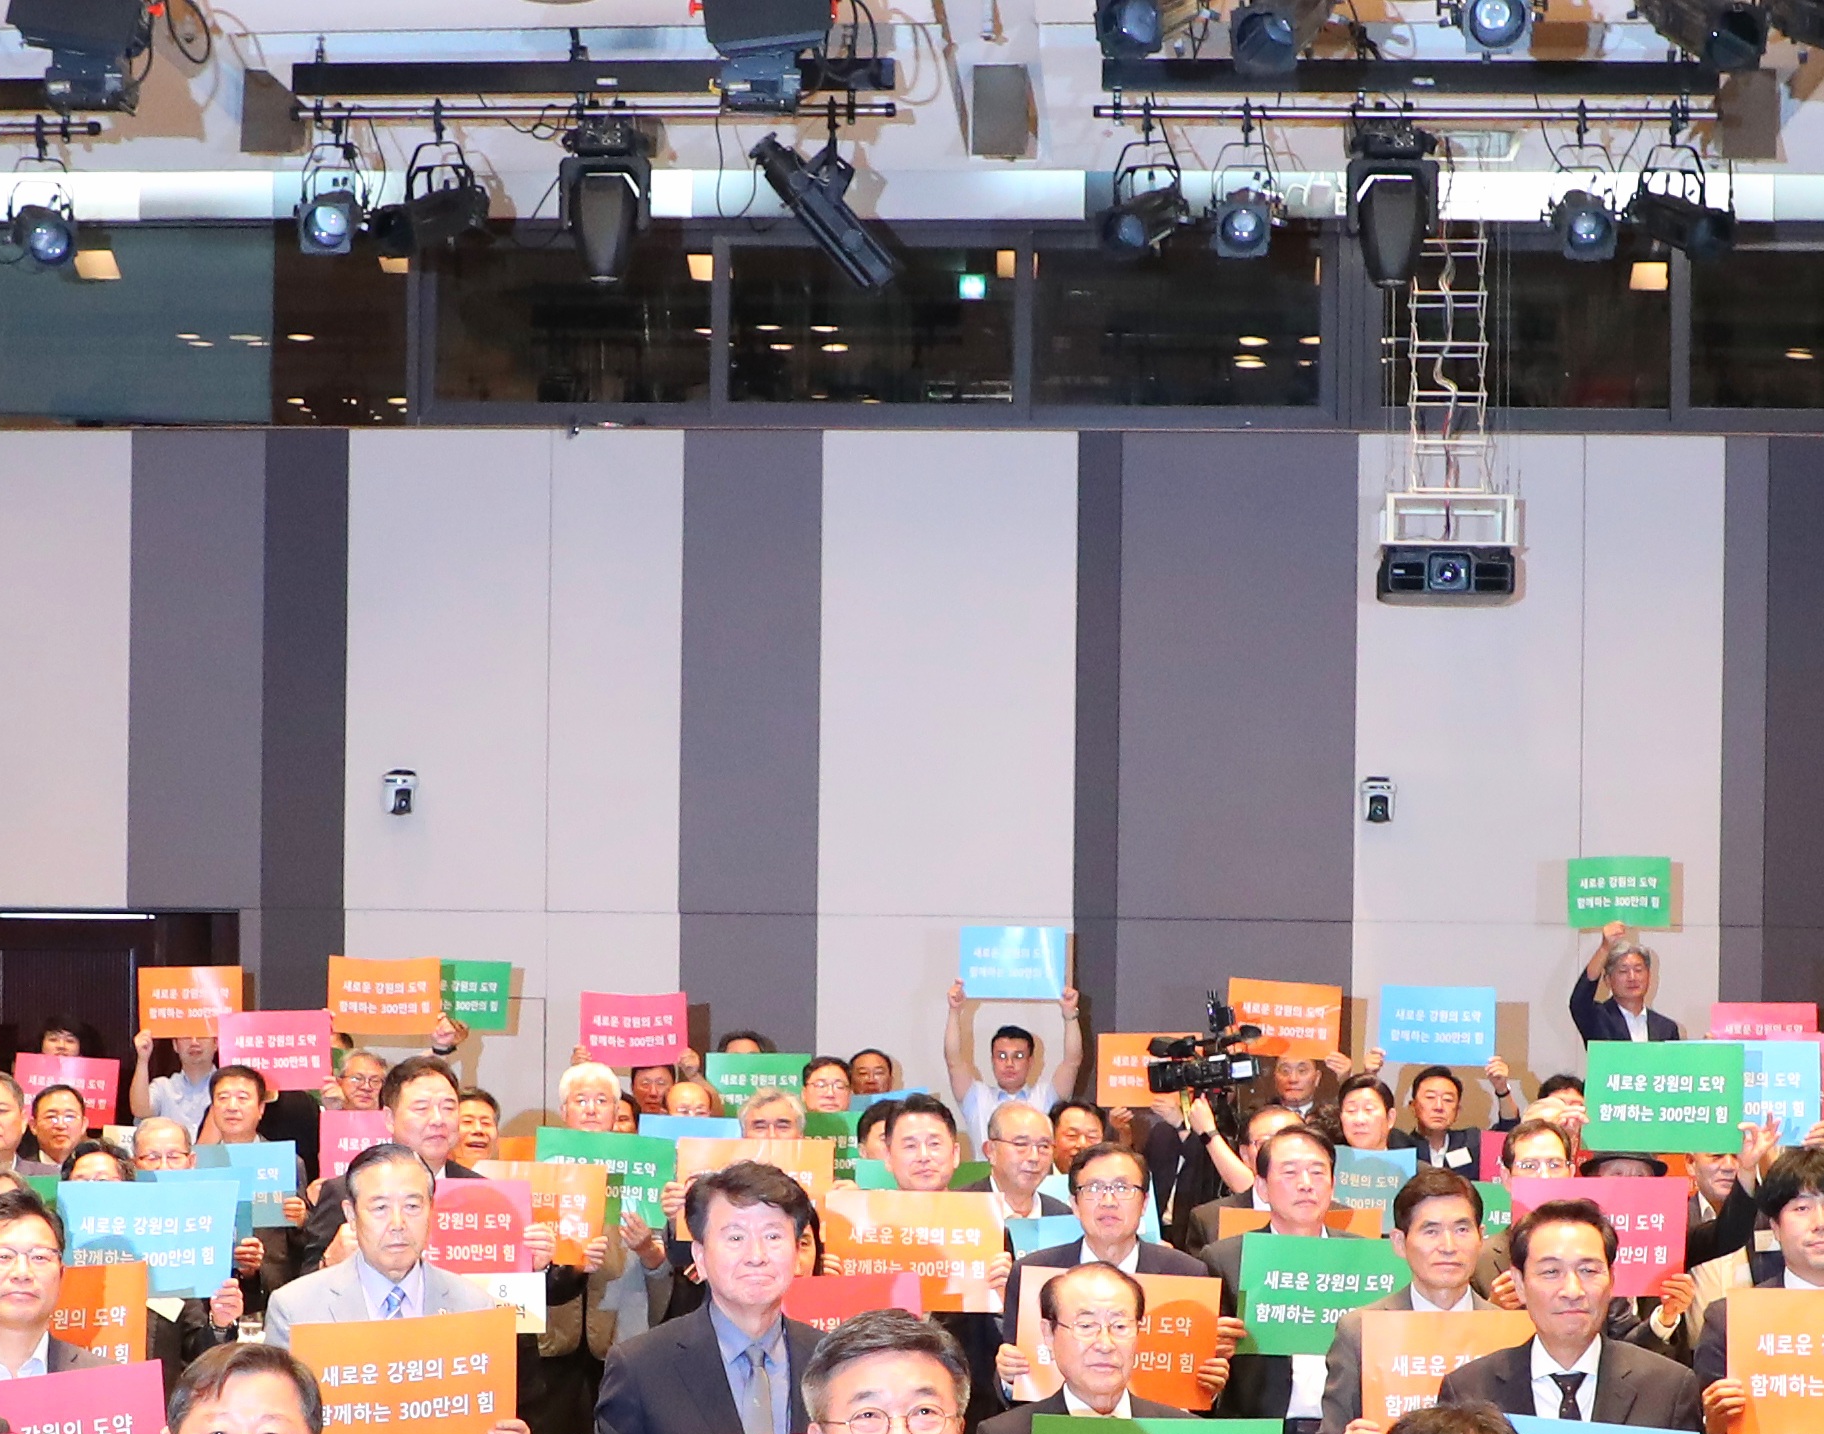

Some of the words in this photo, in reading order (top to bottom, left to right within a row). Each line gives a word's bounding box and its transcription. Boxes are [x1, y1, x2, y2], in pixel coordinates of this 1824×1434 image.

[1607, 1074, 1647, 1092] 새로운
[1653, 1075, 1693, 1093] 강원의
[1698, 1076, 1724, 1093] 도약
[1600, 1104, 1654, 1122] 함께하는
[1658, 1106, 1710, 1123] 300만의
[1716, 1105, 1728, 1124] 힘
[499, 1285, 507, 1297] 8
[320, 1364, 379, 1387] 새로운
[387, 1358, 443, 1383] 강원의
[451, 1354, 488, 1376] 도약
[398, 1393, 469, 1420] 300만의
[477, 1391, 493, 1413] 힘
